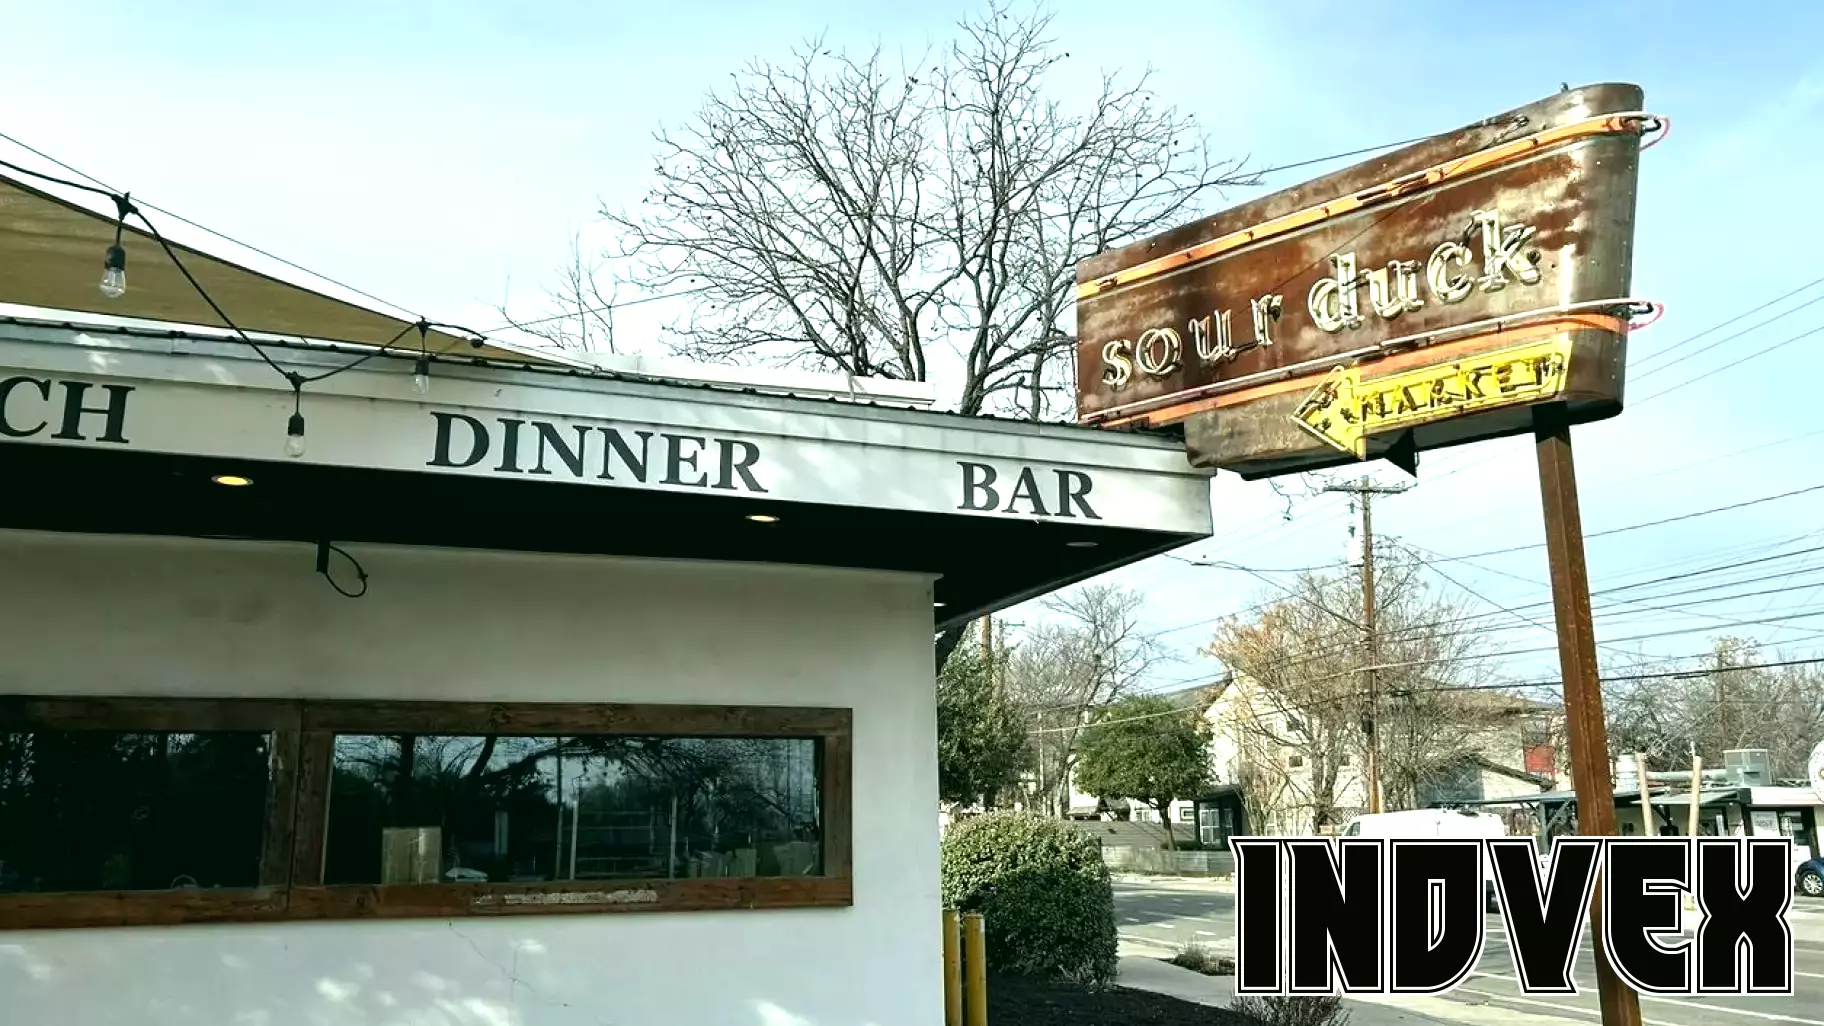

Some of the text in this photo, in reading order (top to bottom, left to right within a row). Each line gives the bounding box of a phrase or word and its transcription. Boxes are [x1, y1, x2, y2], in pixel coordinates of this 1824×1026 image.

[1102, 209, 1540, 386] sour duck
[0, 376, 1103, 520] CH DINNER BAR
